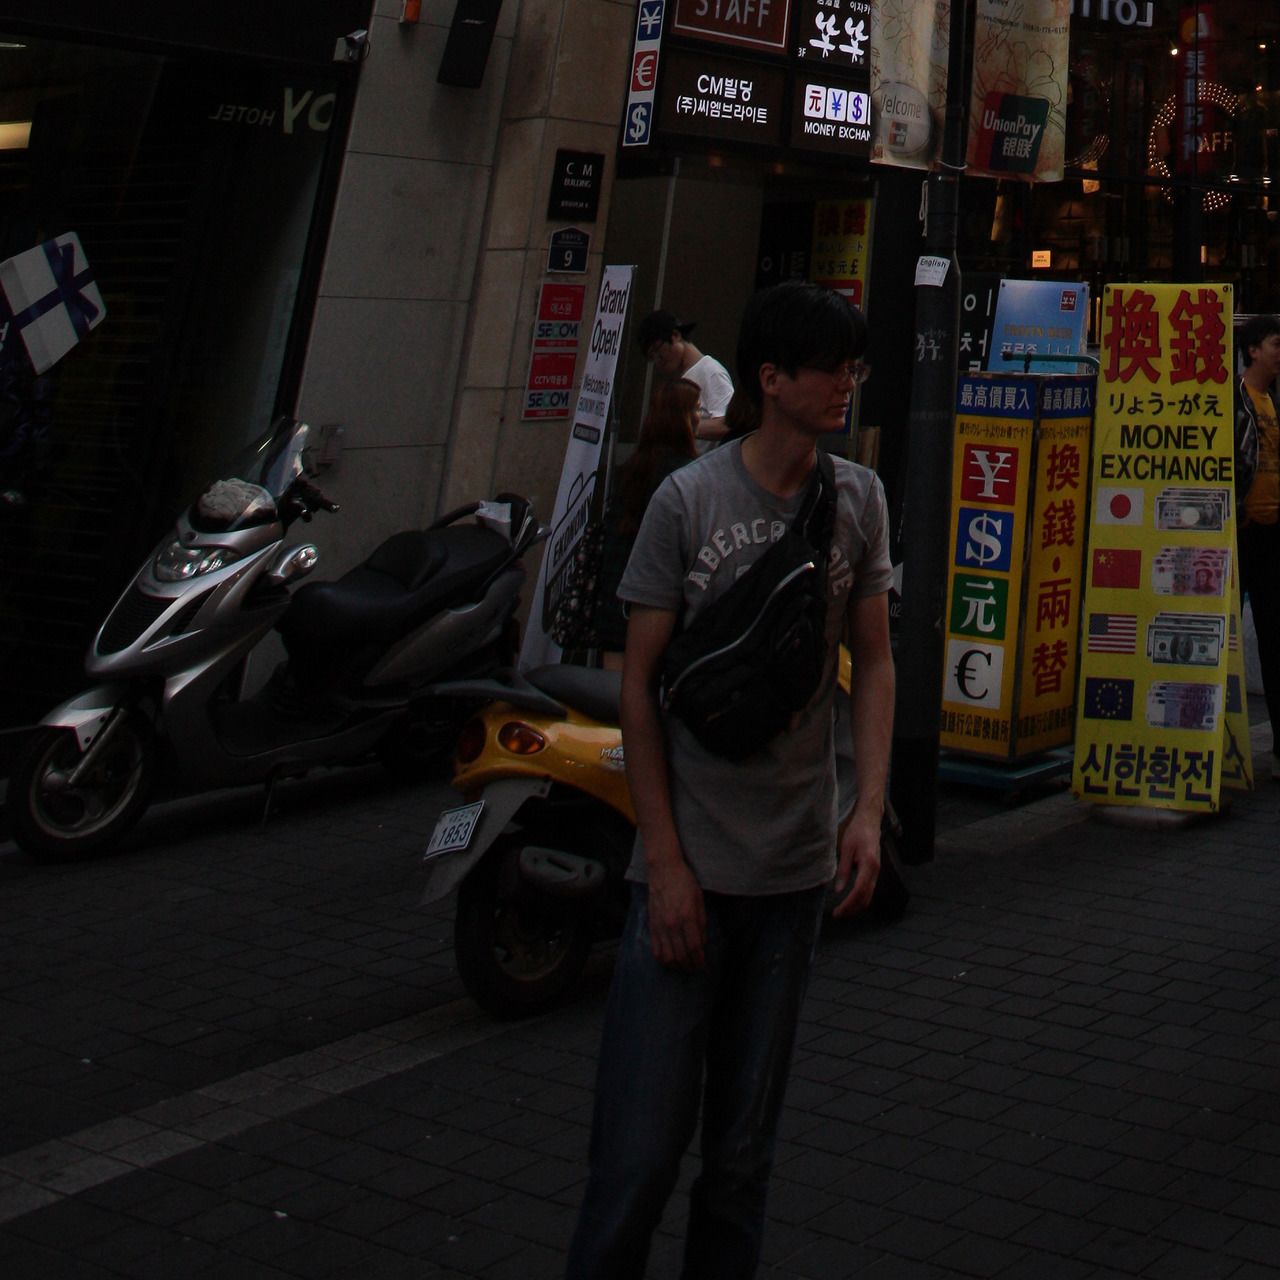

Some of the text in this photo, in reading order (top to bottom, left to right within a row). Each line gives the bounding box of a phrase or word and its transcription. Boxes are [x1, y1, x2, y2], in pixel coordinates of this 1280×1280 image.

[849, 0, 871, 16] 이자카
[696, 74, 754, 103] CM빌딩
[675, 95, 769, 124] (주)씨엠브라이트
[803, 121, 872, 142] MONEY EXCHAN
[983, 108, 1042, 142] UnionPay
[563, 249, 573, 268] 9
[919, 257, 948, 269] English
[600, 280, 629, 315] Grand
[537, 322, 578, 339] SECOM
[591, 319, 622, 361] Open!
[1103, 288, 1229, 386] 換錢
[527, 391, 570, 409] SECOM
[1119, 424, 1219, 451] MONEY
[1100, 454, 1233, 482] EXCHANGE
[964, 512, 1004, 567] $
[960, 579, 998, 634] 元
[953, 649, 992, 700] €
[1079, 742, 1218, 804] 신한환전
